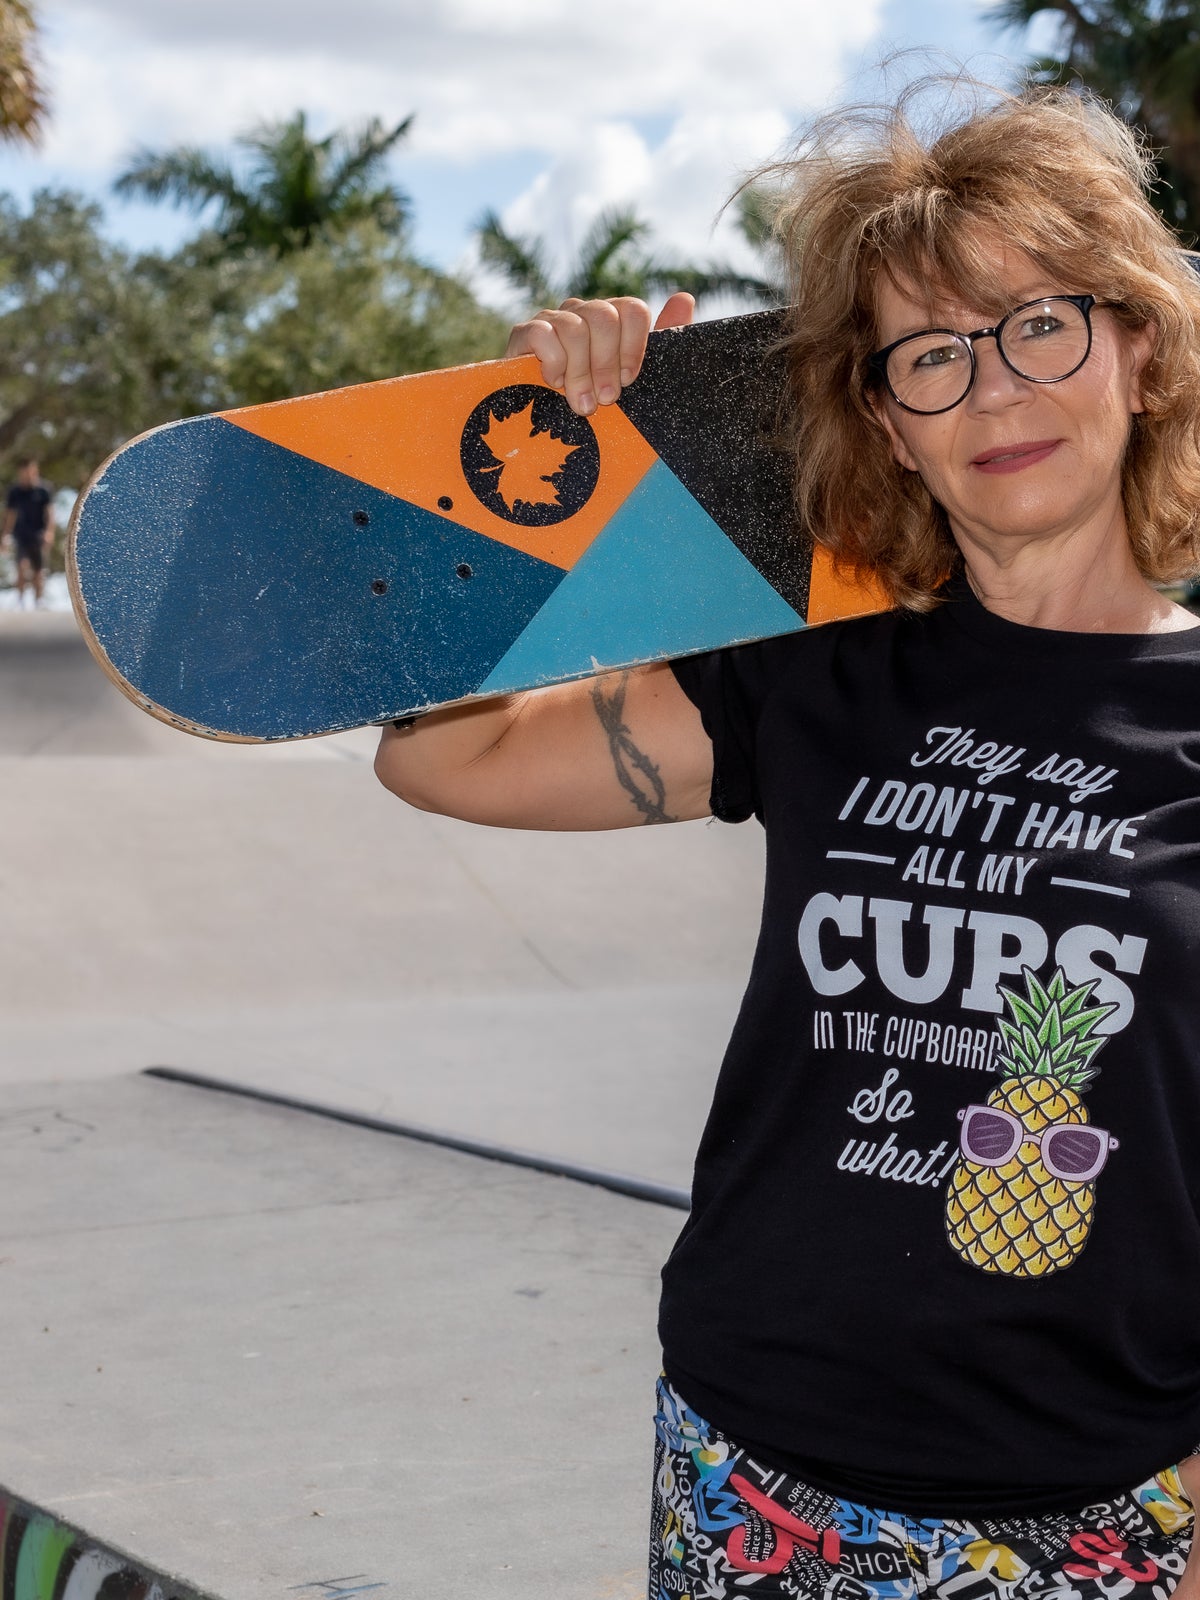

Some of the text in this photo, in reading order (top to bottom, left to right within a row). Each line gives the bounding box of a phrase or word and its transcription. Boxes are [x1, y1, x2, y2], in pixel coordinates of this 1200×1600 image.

[910, 726, 1119, 804] They say
[838, 776, 1147, 860] I DON'T HAVE
[902, 845, 1038, 895] ALL MY
[798, 892, 1149, 1035] CUPS
[813, 1010, 835, 1050] IN
[843, 1011, 879, 1053] THE
[847, 1068, 915, 1123] So
[836, 1133, 960, 1187] what!
[660, 1568, 690, 1594] ISSUE
